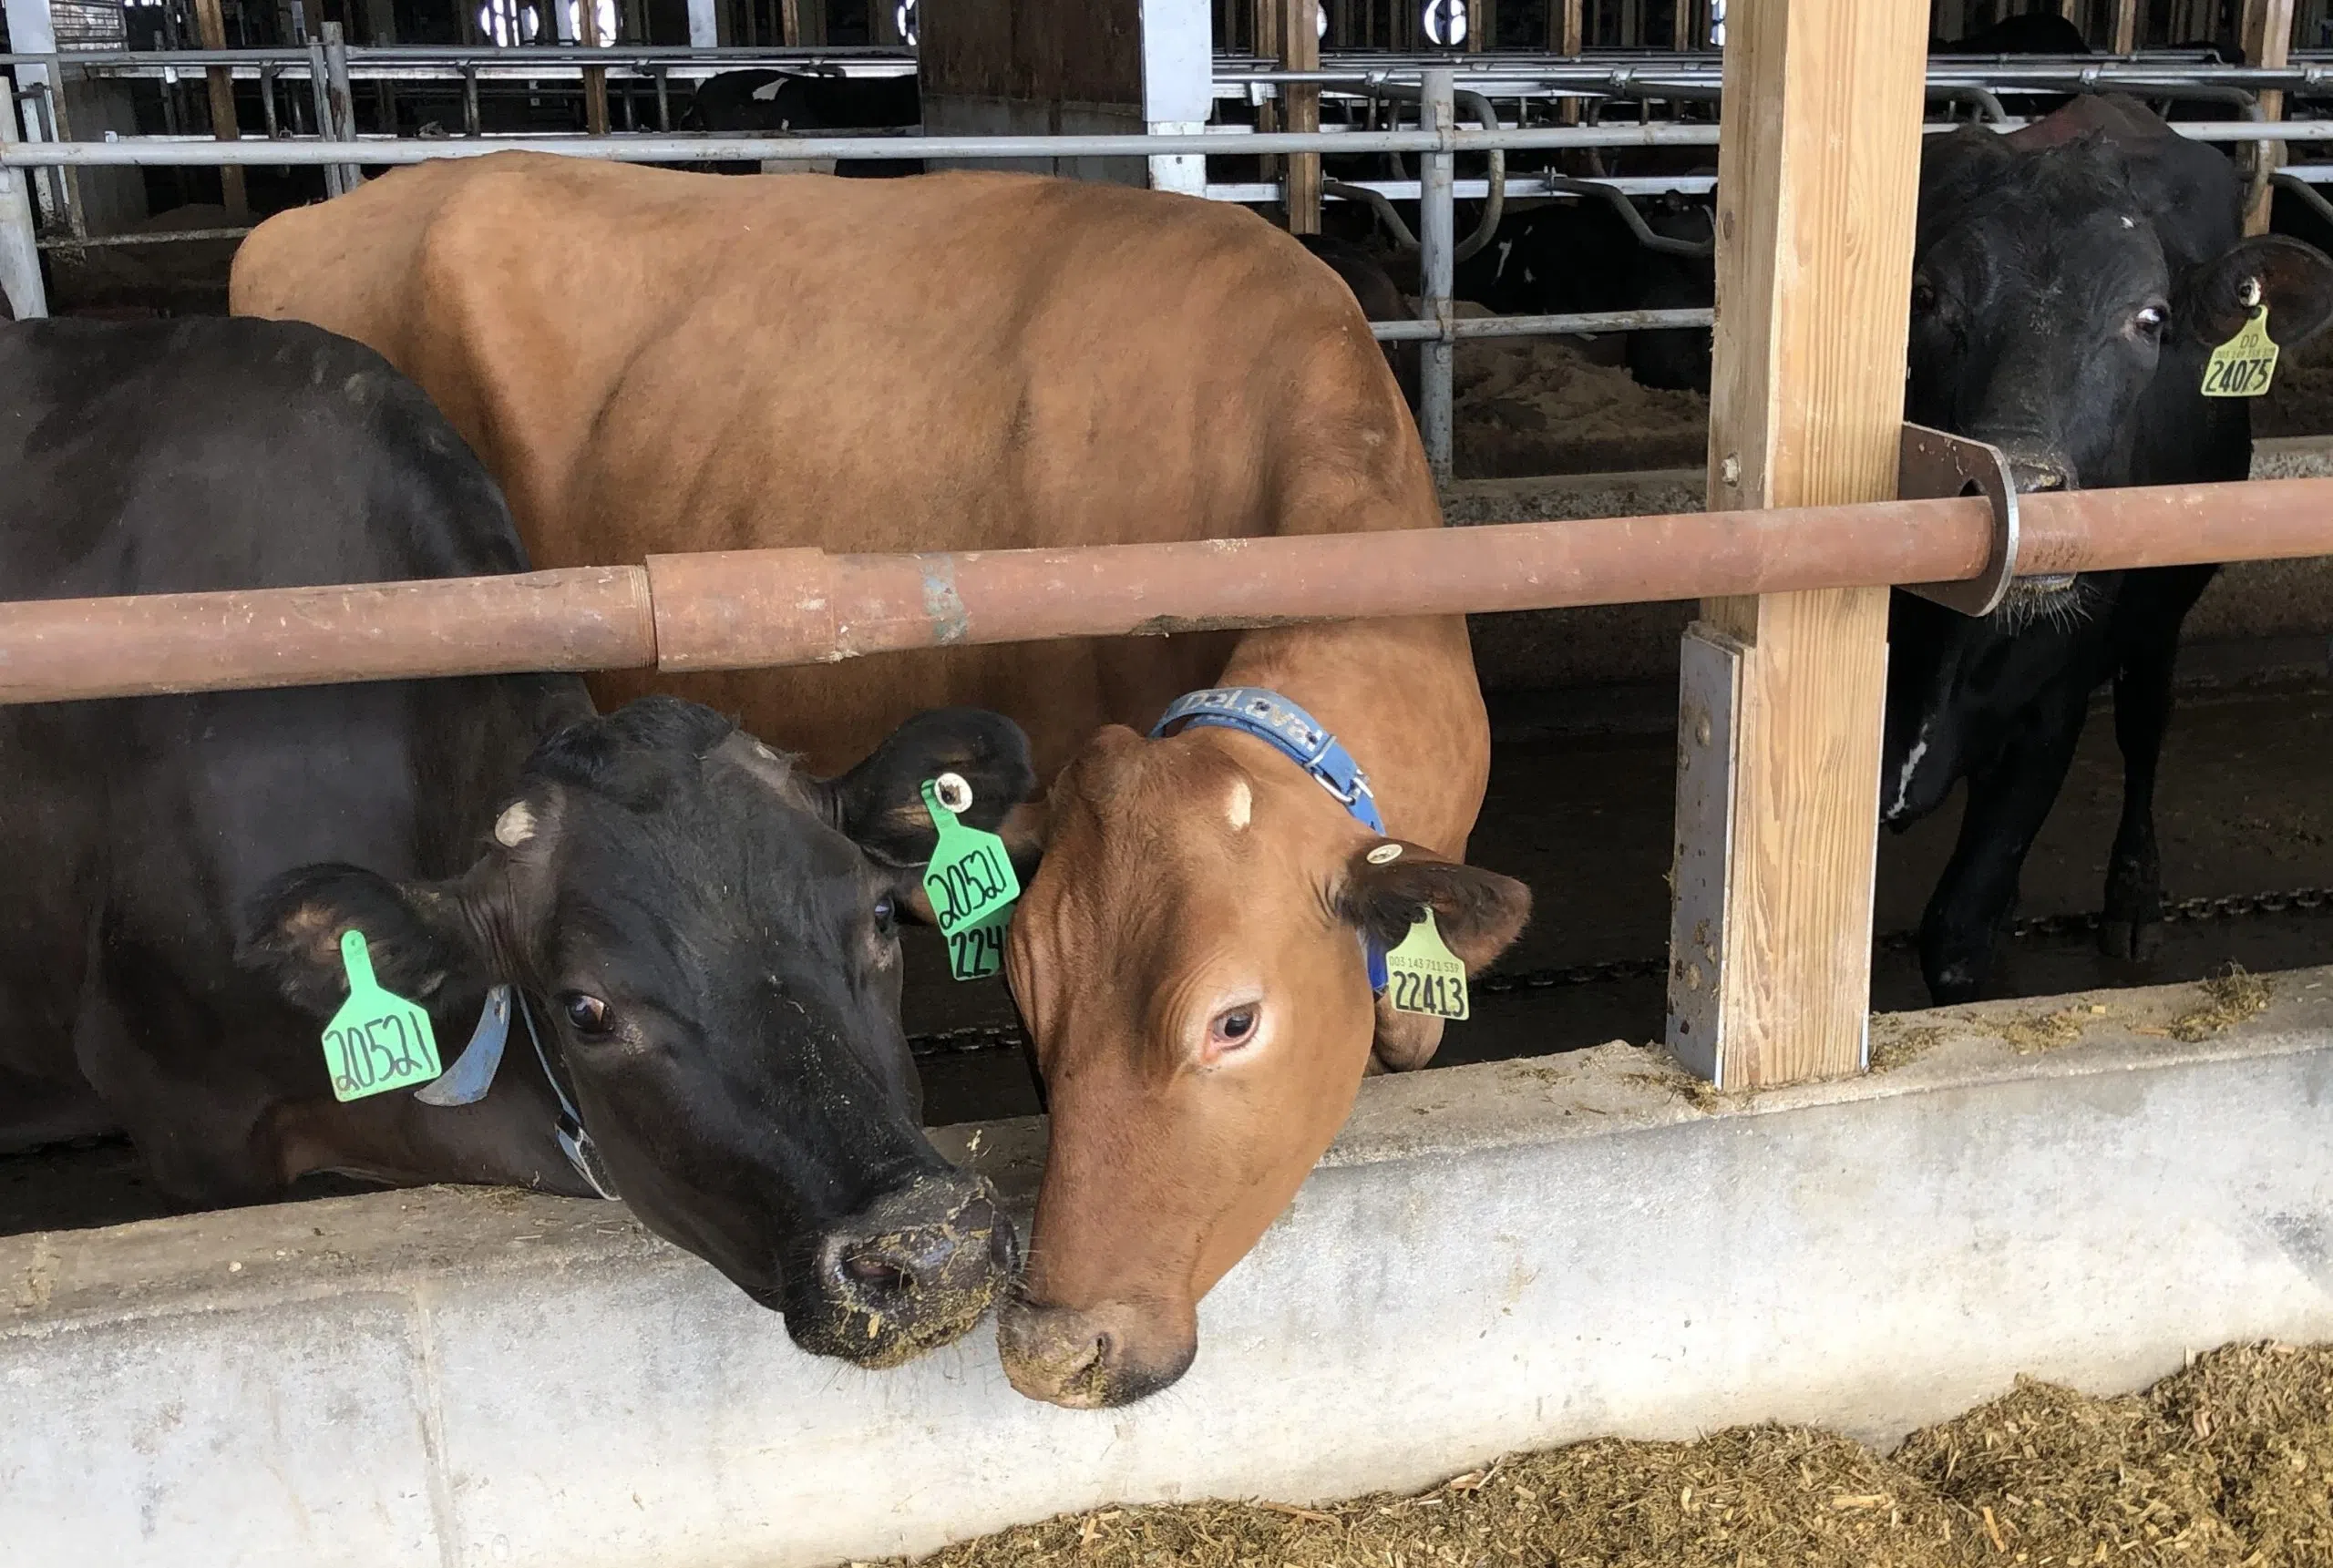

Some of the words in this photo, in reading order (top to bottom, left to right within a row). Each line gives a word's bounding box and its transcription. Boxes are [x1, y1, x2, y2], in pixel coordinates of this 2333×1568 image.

[2205, 358, 2272, 393] 24075
[928, 845, 1007, 930] 20521
[951, 925, 1009, 979] 224
[1393, 970, 1465, 1018] 22413
[324, 1010, 436, 1092] 20521
